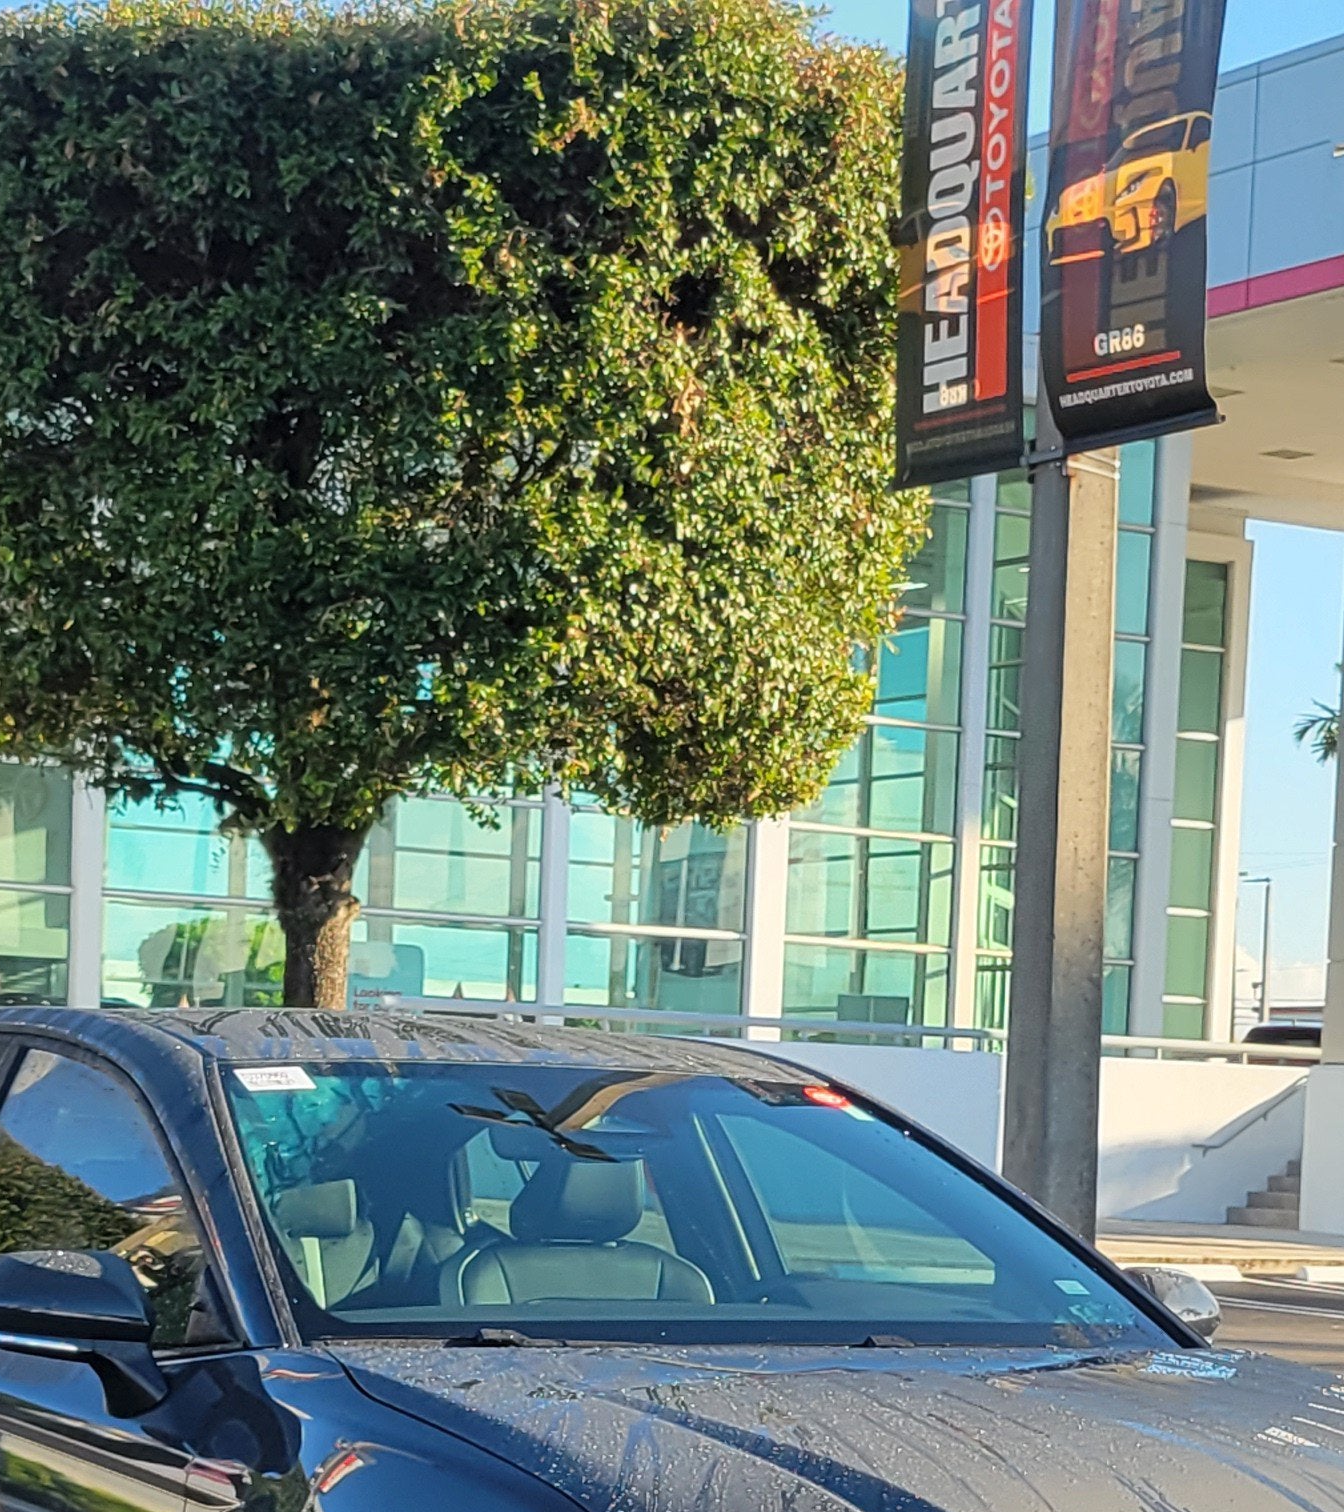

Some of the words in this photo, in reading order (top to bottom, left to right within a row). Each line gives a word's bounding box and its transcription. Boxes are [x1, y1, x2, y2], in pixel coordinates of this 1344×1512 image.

[985, 0, 1016, 199] TOYOTA
[1093, 323, 1146, 356] GR86
[1058, 367, 1195, 409] HEADQUARTERTOYOTA.COM
